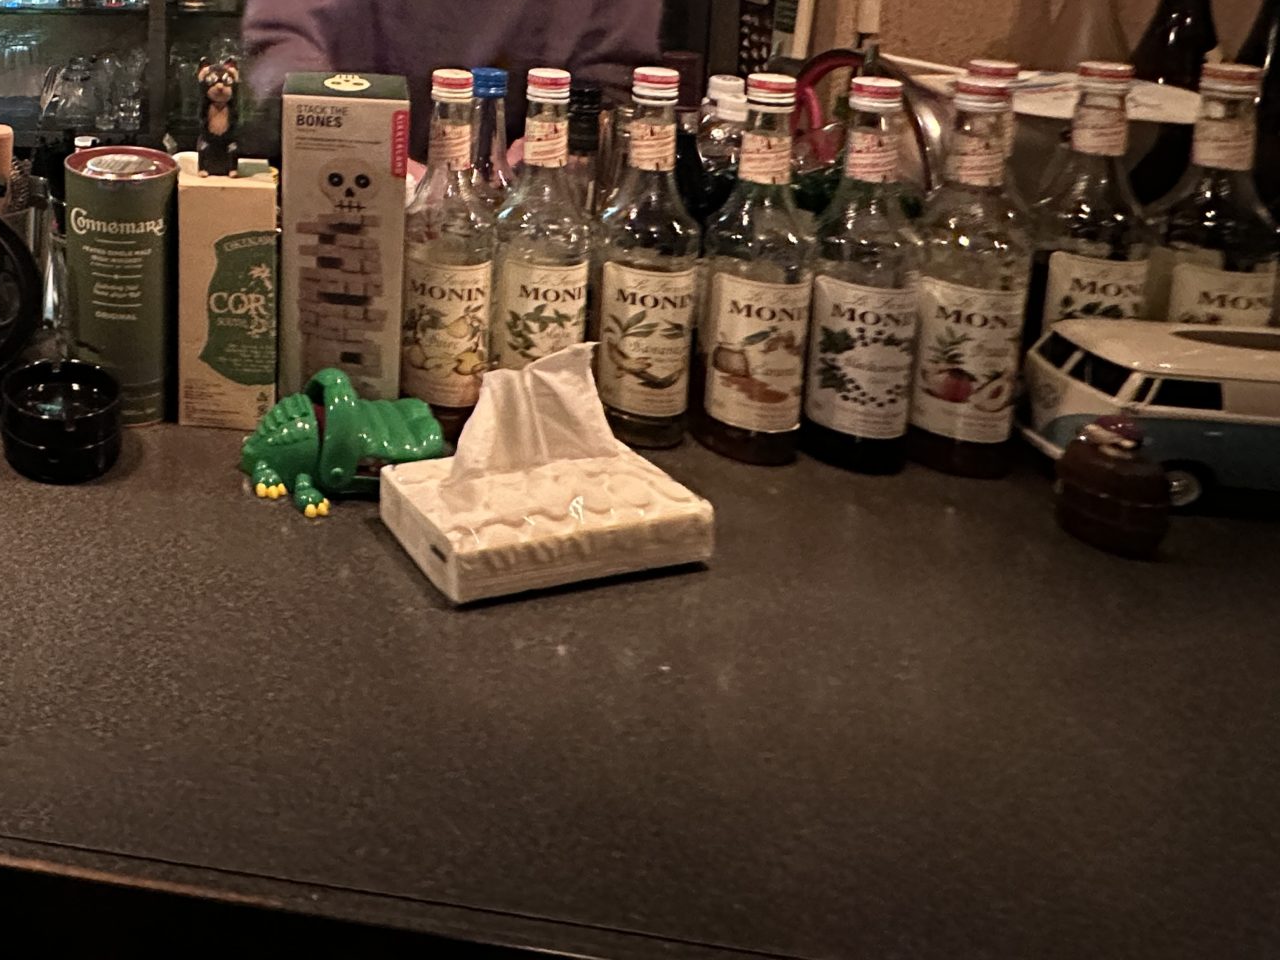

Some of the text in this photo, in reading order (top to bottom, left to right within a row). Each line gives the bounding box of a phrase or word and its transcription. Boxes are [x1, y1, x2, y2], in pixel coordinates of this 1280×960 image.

[295, 104, 350, 116] STACK THE
[296, 114, 344, 129] BONES
[70, 207, 168, 236] Connemara
[519, 284, 585, 302] MONI
